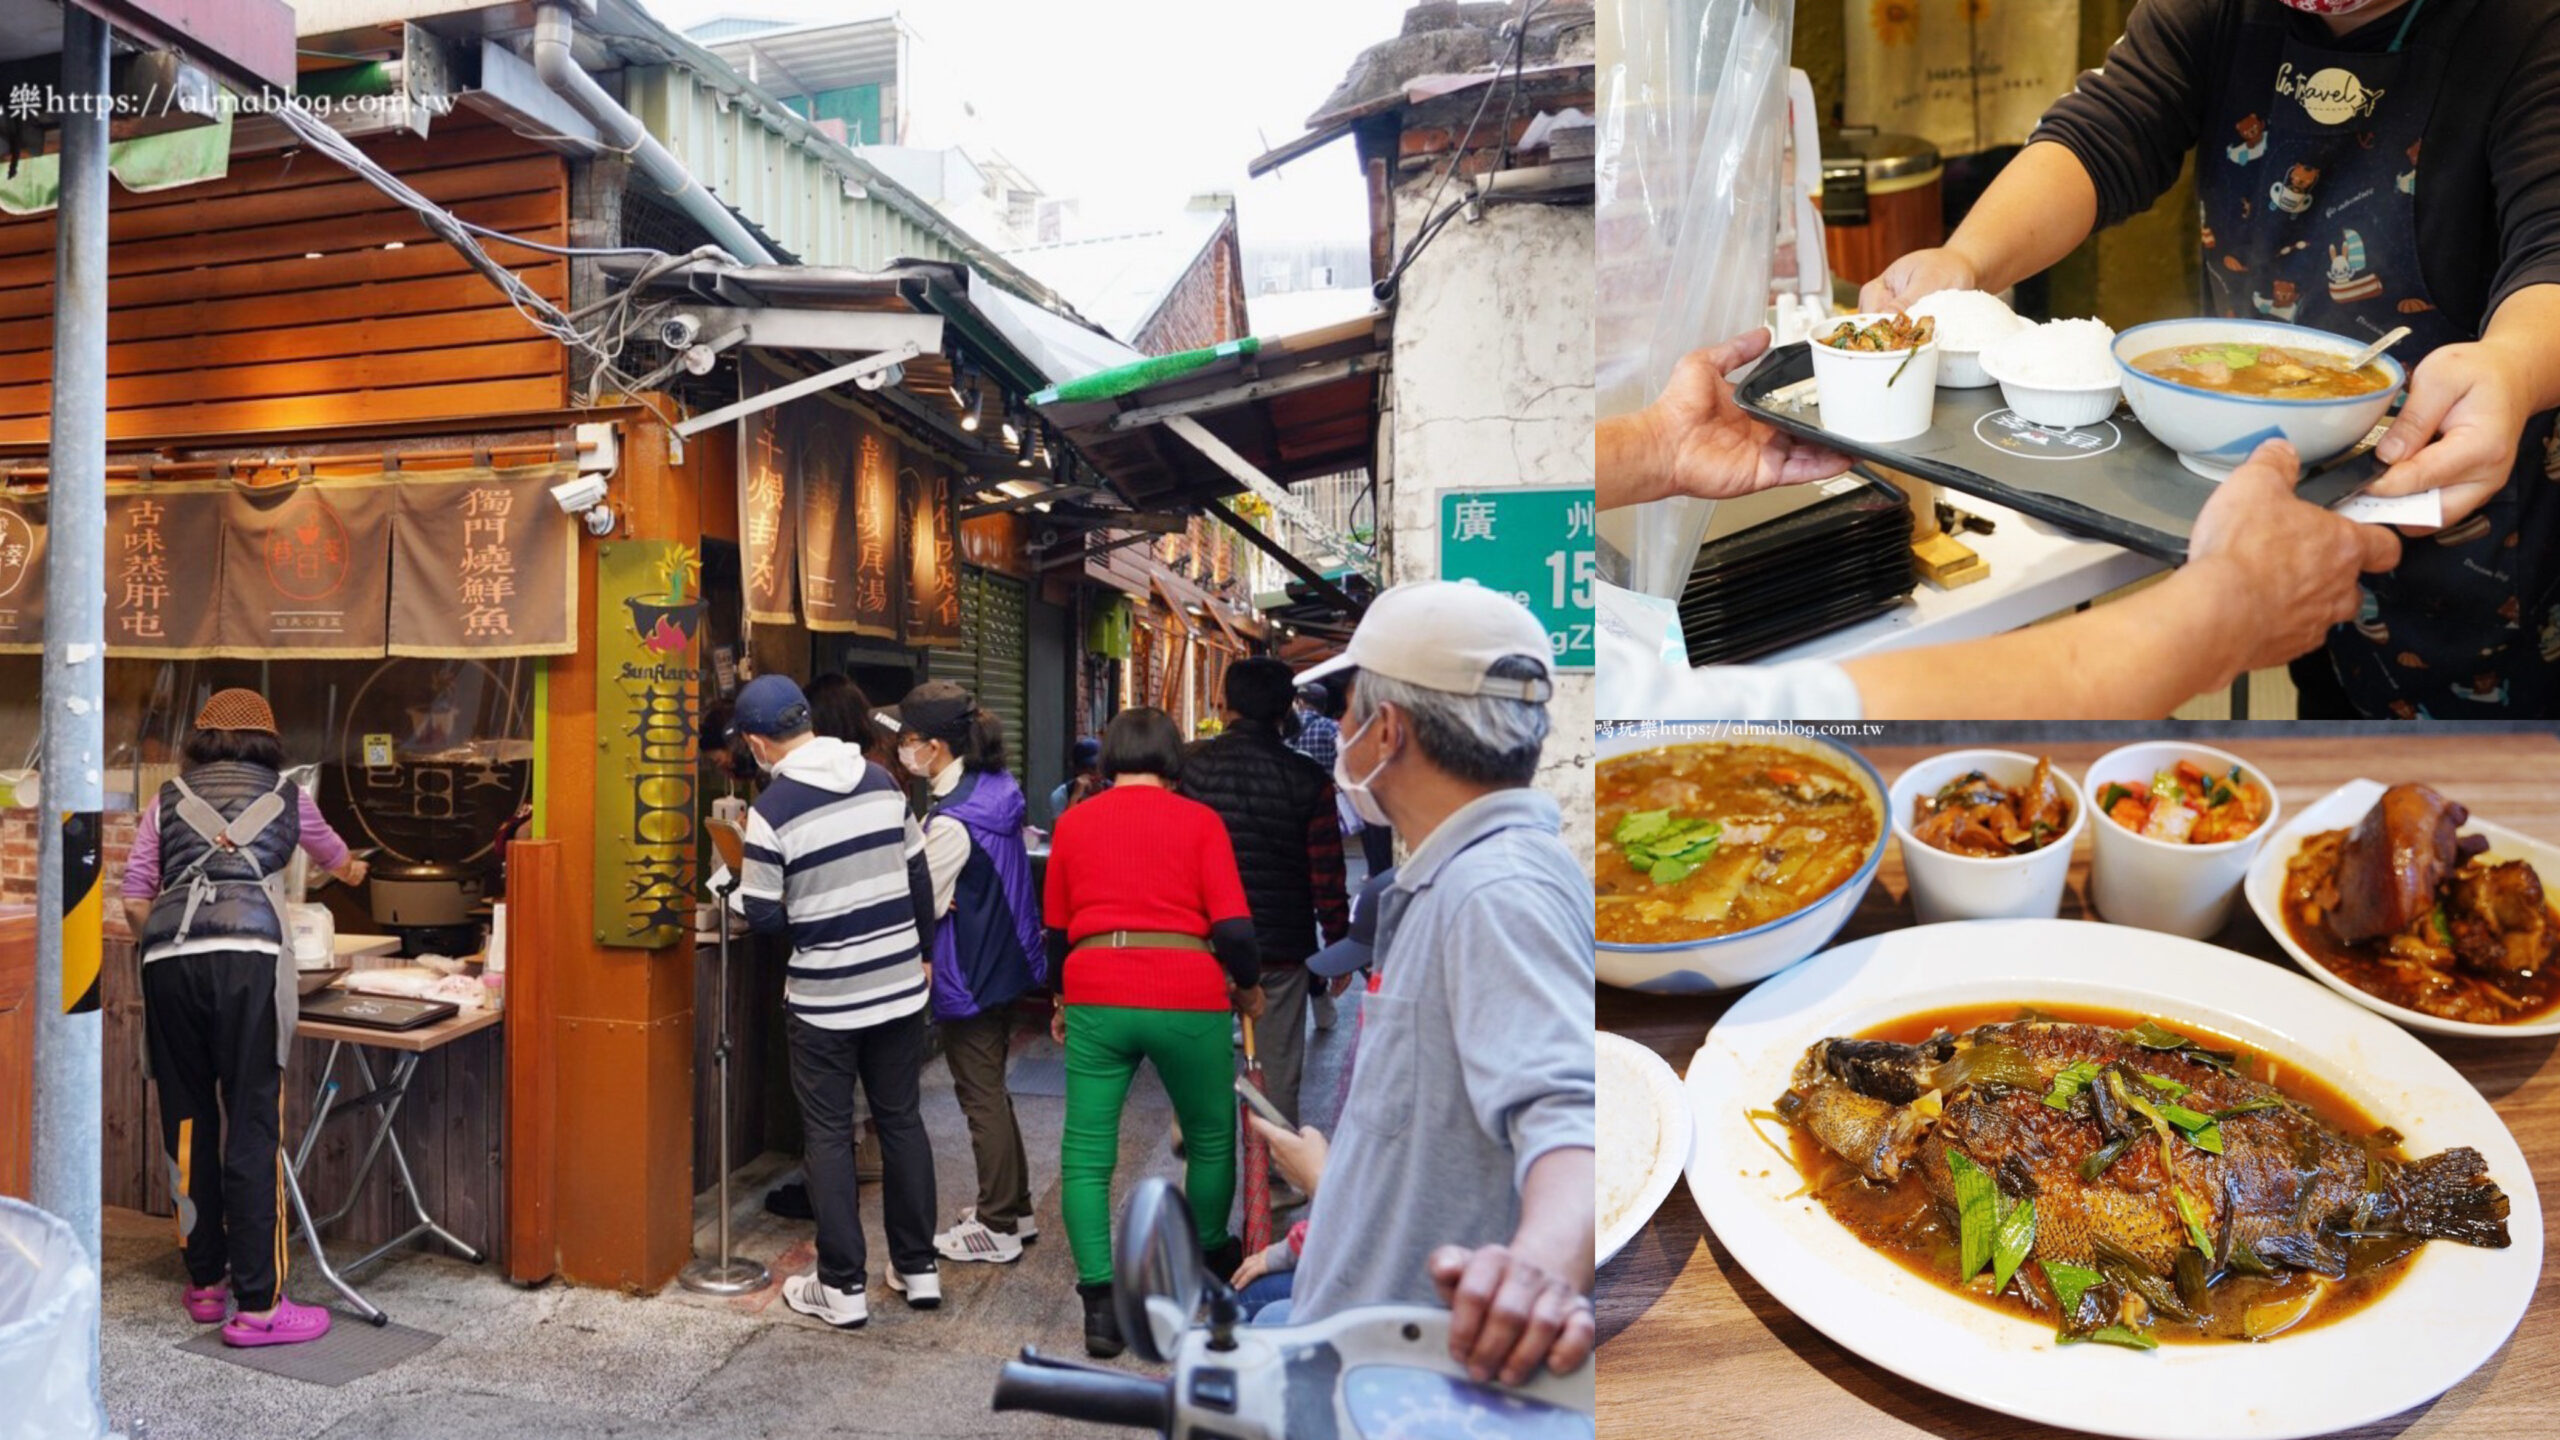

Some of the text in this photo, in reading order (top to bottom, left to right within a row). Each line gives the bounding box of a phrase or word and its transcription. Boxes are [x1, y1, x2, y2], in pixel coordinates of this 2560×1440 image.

[456, 487, 516, 637] 獨門燒鮮魚
